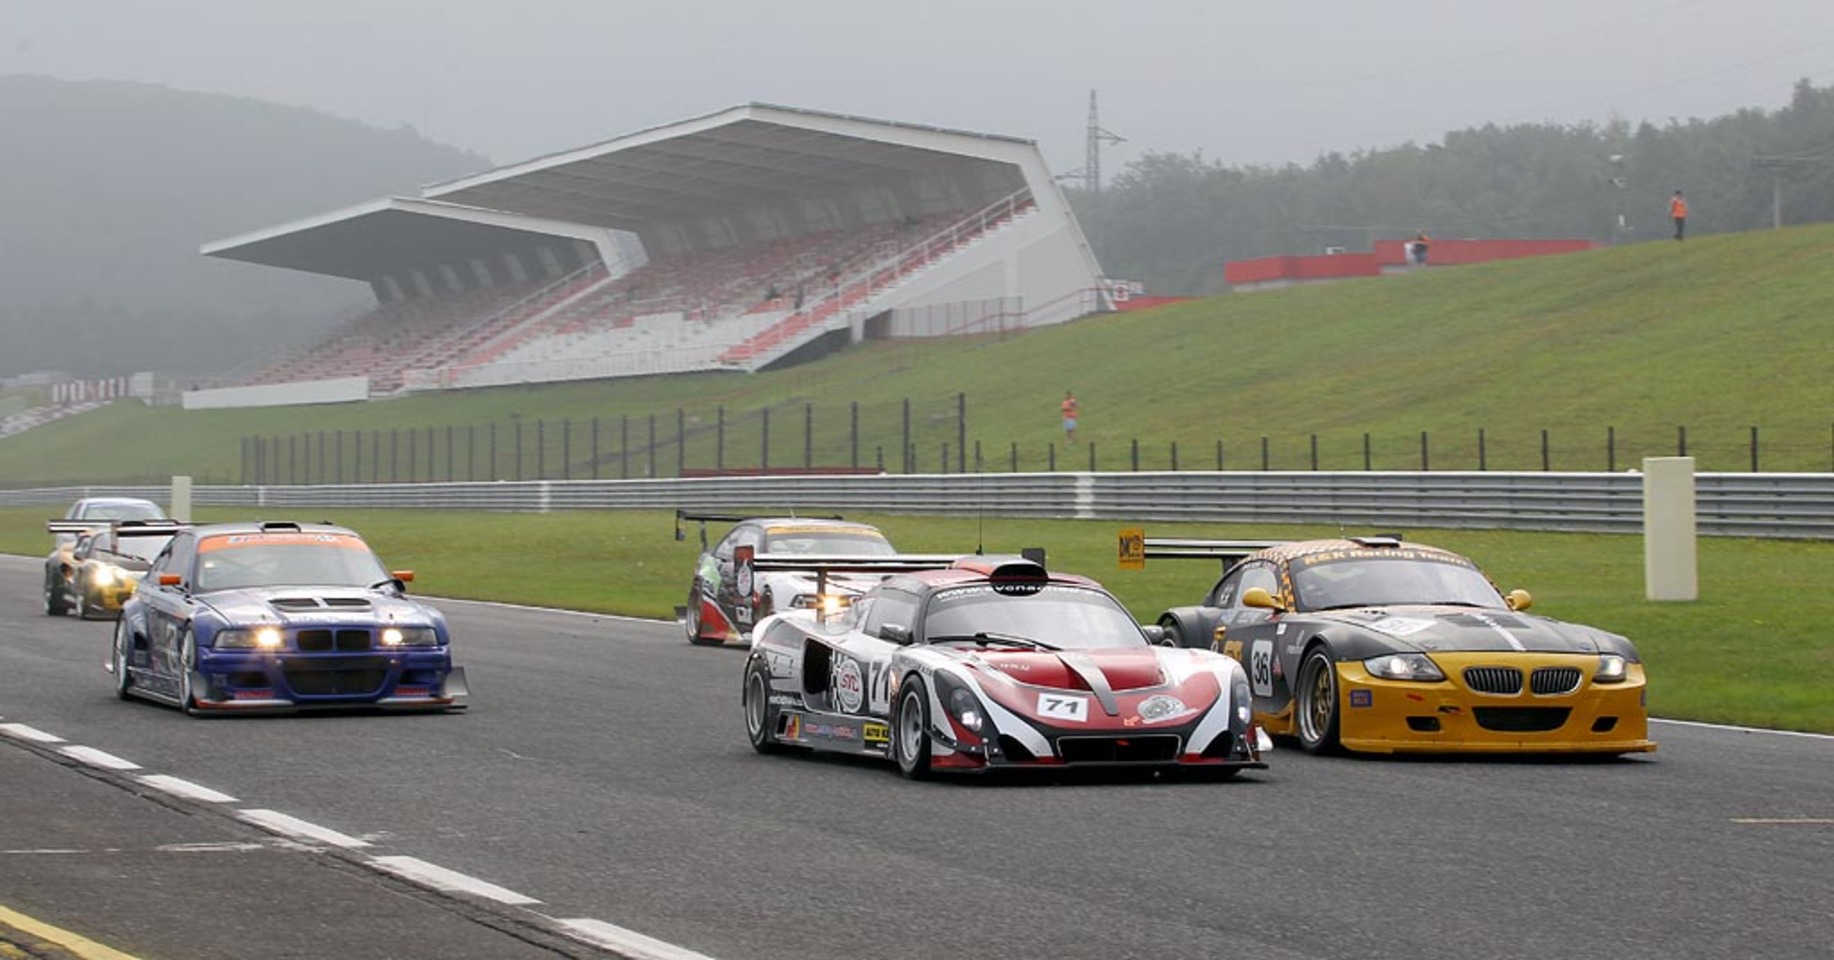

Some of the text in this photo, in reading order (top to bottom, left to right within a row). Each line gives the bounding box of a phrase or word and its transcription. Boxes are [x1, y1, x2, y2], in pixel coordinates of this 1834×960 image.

[1350, 548, 1414, 560] Racing
[1417, 551, 1468, 566] Team
[1253, 651, 1269, 685] 36
[871, 662, 889, 703] 71
[1046, 698, 1078, 713] 71
